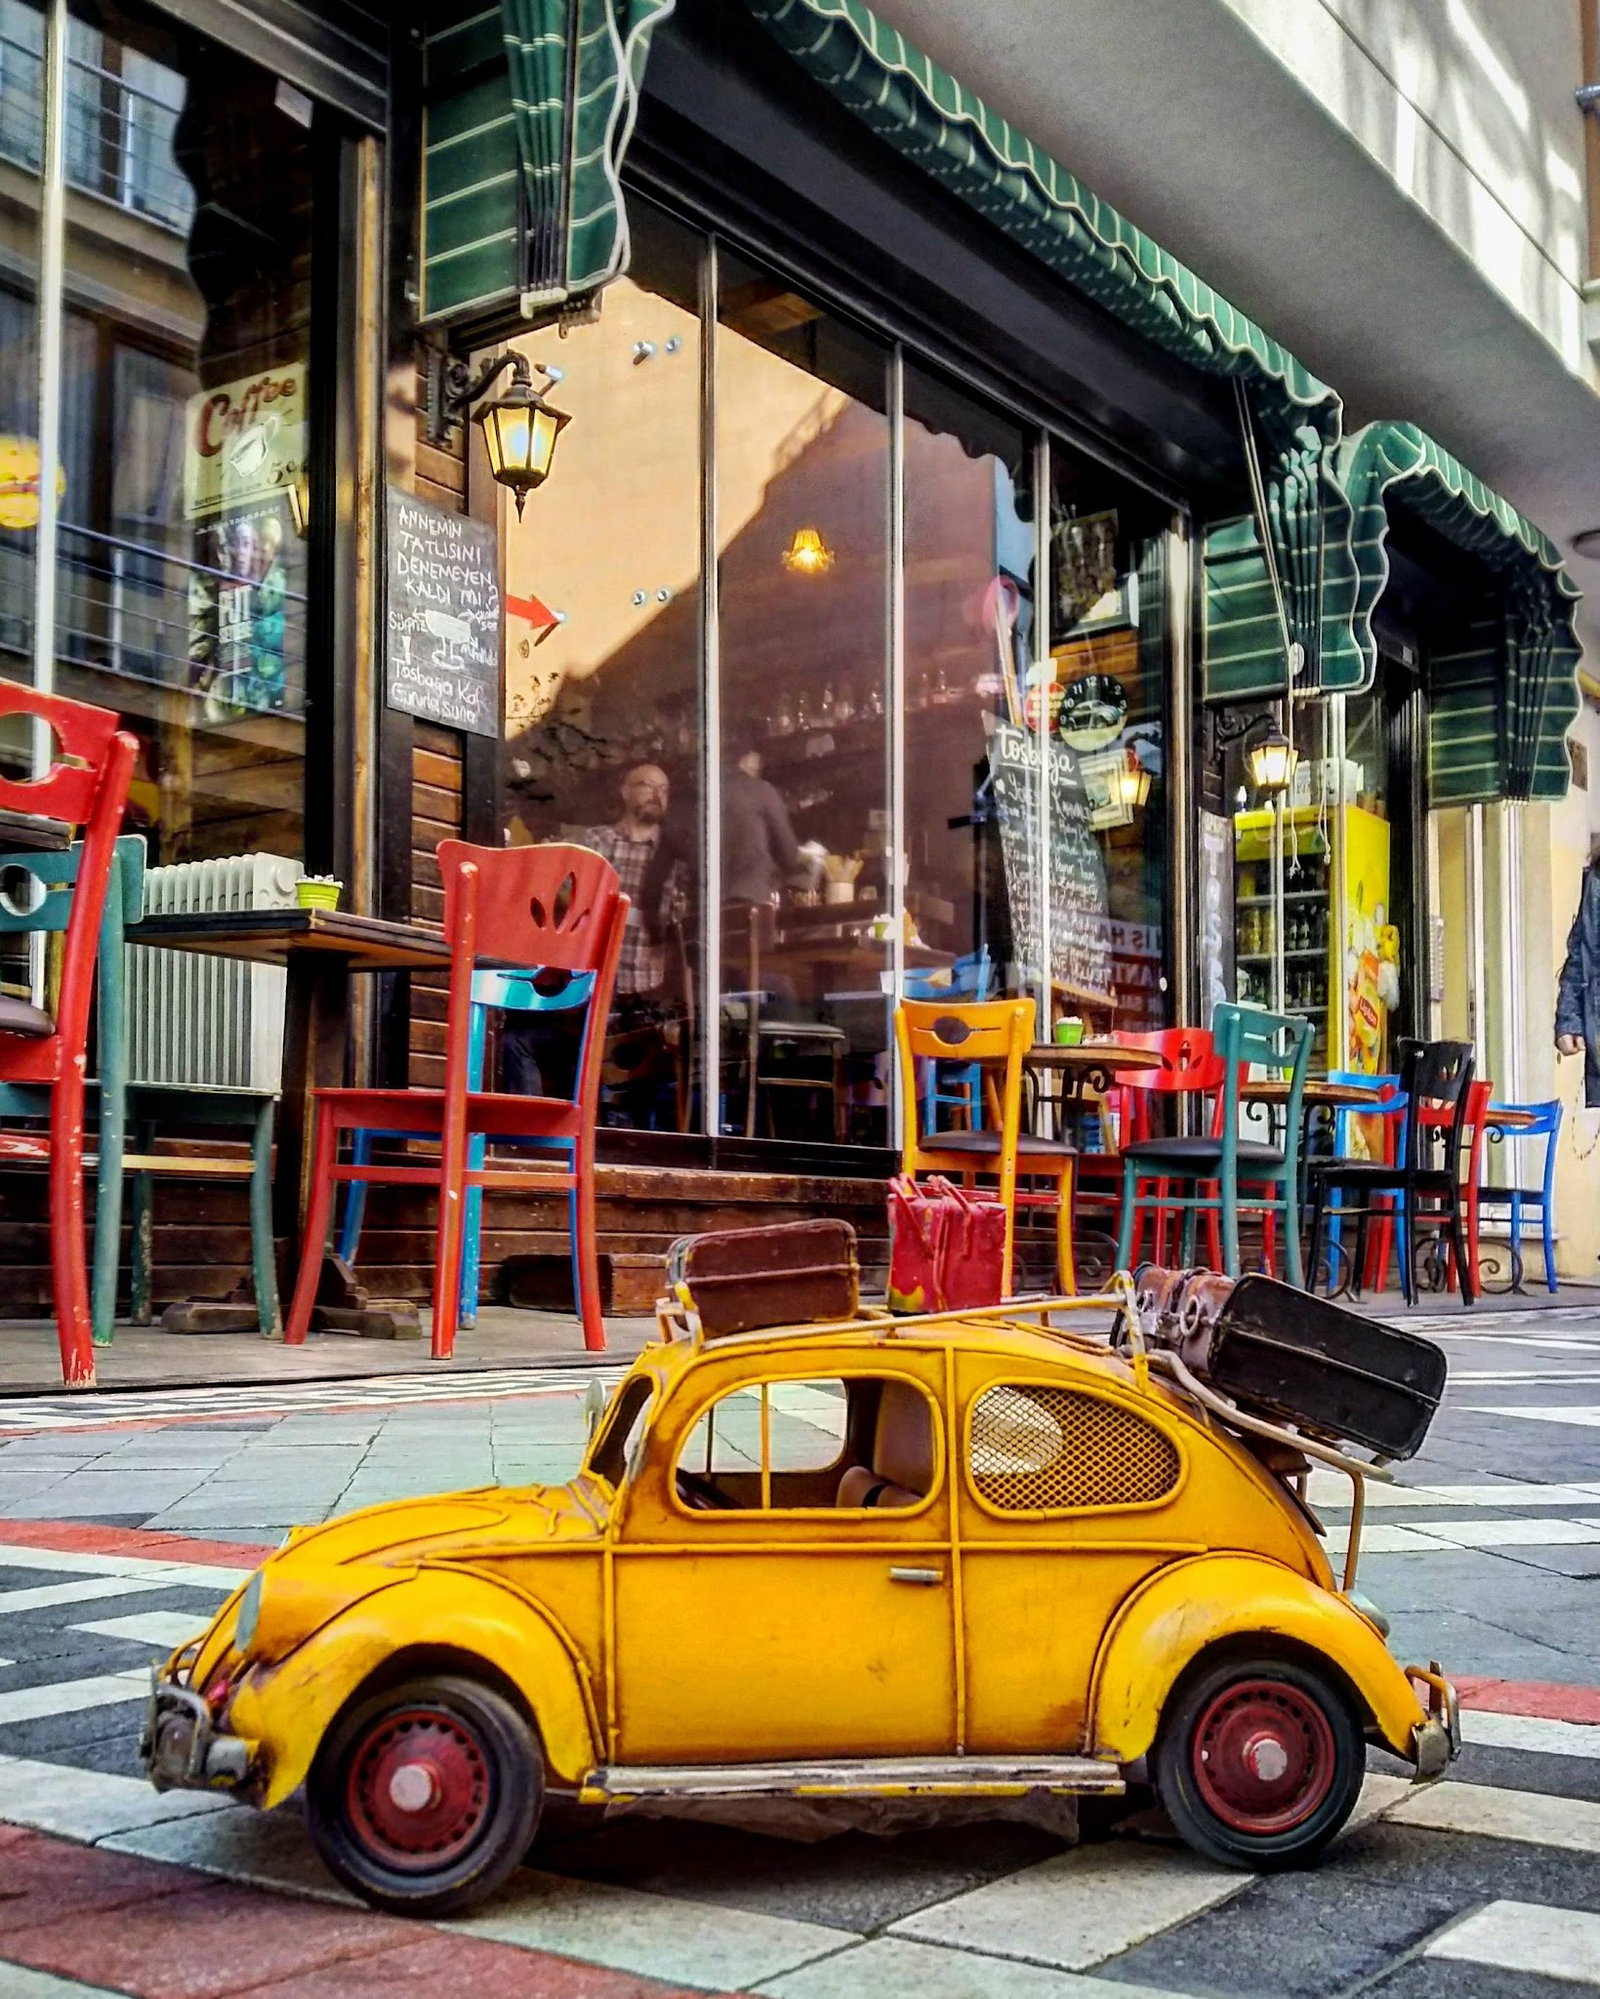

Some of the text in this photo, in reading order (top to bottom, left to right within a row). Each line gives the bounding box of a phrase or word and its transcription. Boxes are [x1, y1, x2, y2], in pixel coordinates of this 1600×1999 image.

[198, 376, 297, 457] Coffee
[397, 550, 492, 587] DENEMEYEN
[405, 575, 451, 605] KALDI
[1072, 683, 1083, 695] 11
[1085, 675, 1097, 687] 12
[1114, 685, 1122, 696] 2
[1064, 697, 1075, 709] 10
[996, 724, 1075, 787] tosbğa
